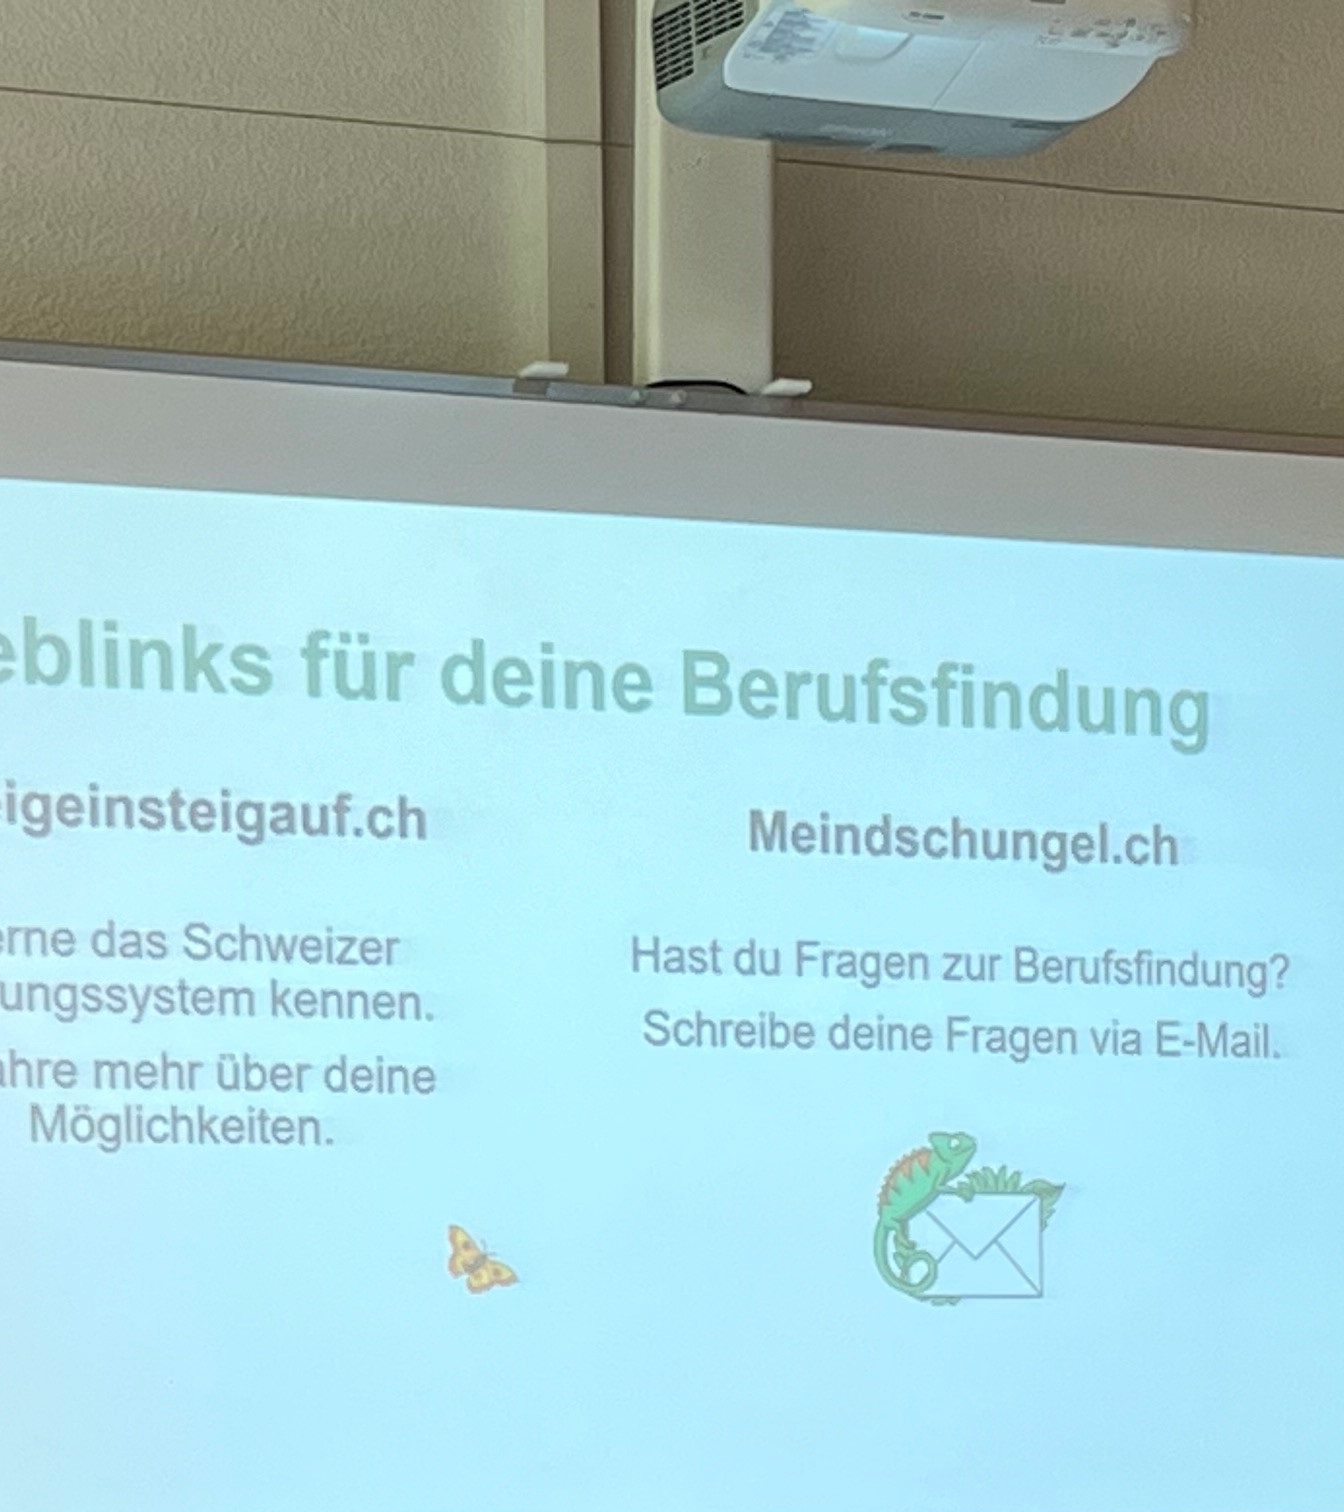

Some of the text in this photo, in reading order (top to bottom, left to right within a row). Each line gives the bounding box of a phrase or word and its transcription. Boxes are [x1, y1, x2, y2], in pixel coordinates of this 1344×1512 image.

[300, 629, 416, 702] für
[440, 638, 653, 714] deine
[680, 648, 1212, 756] Berufsfindung
[748, 807, 1180, 873] Meindschungel.ch
[90, 920, 167, 961] das
[182, 921, 401, 967] Schweizer
[631, 936, 1291, 998] Hast du Fragen zur Berufsfindung?
[270, 978, 436, 1023] kennen.
[642, 1009, 1282, 1063] Schreibe deine Fragen via E-Mail.
[93, 1048, 203, 1093] mehr
[217, 1051, 313, 1095] über
[323, 1054, 438, 1096] deine
[29, 1101, 336, 1154] Möglichkeiten.
